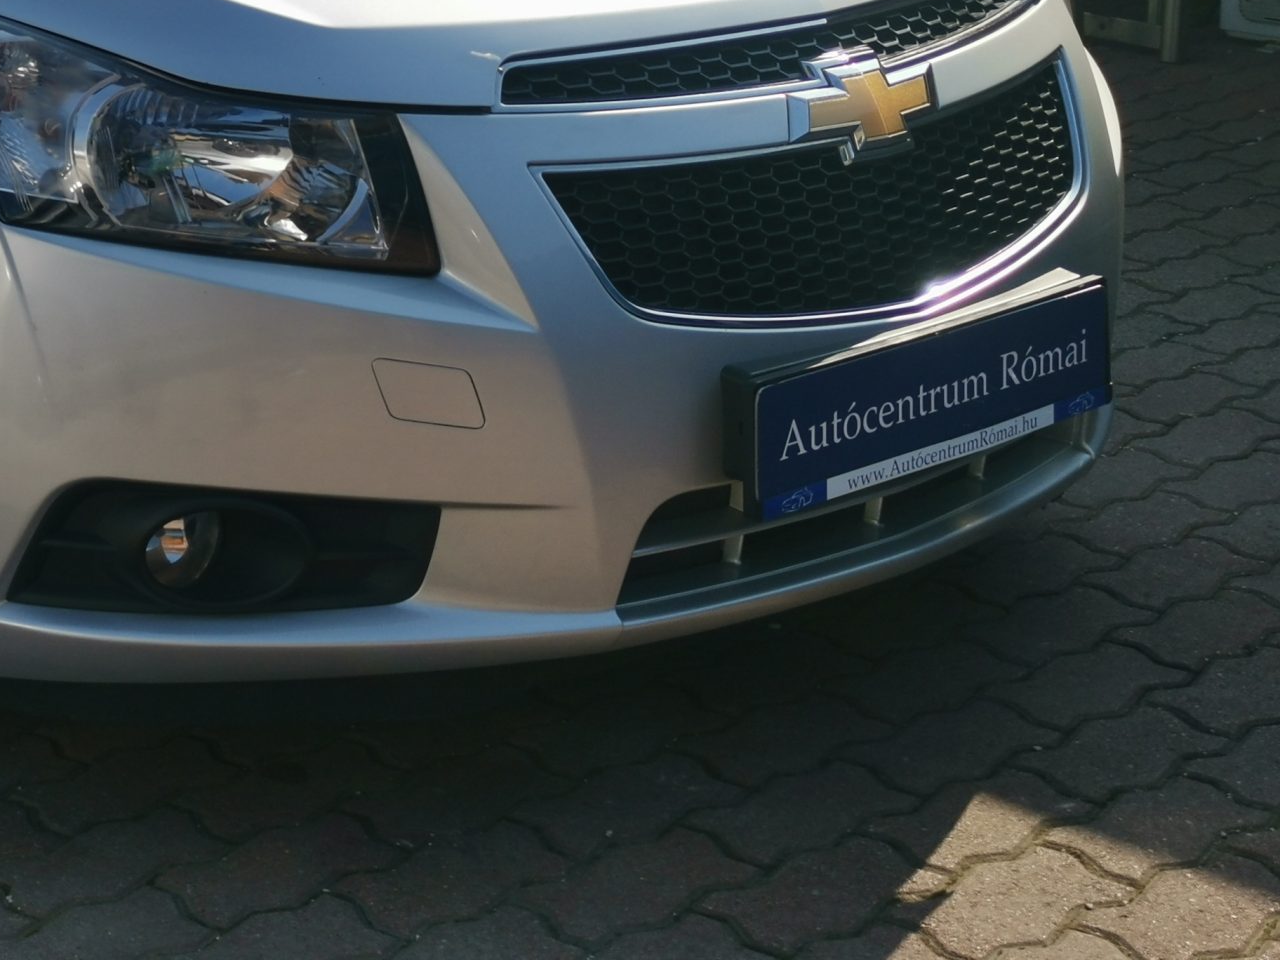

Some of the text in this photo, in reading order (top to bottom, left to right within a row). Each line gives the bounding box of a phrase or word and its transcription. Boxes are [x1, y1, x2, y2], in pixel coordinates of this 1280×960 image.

[780, 328, 1088, 461] Autócentrum Római
[848, 414, 1038, 491] www.AutócentrumRómai.hu
